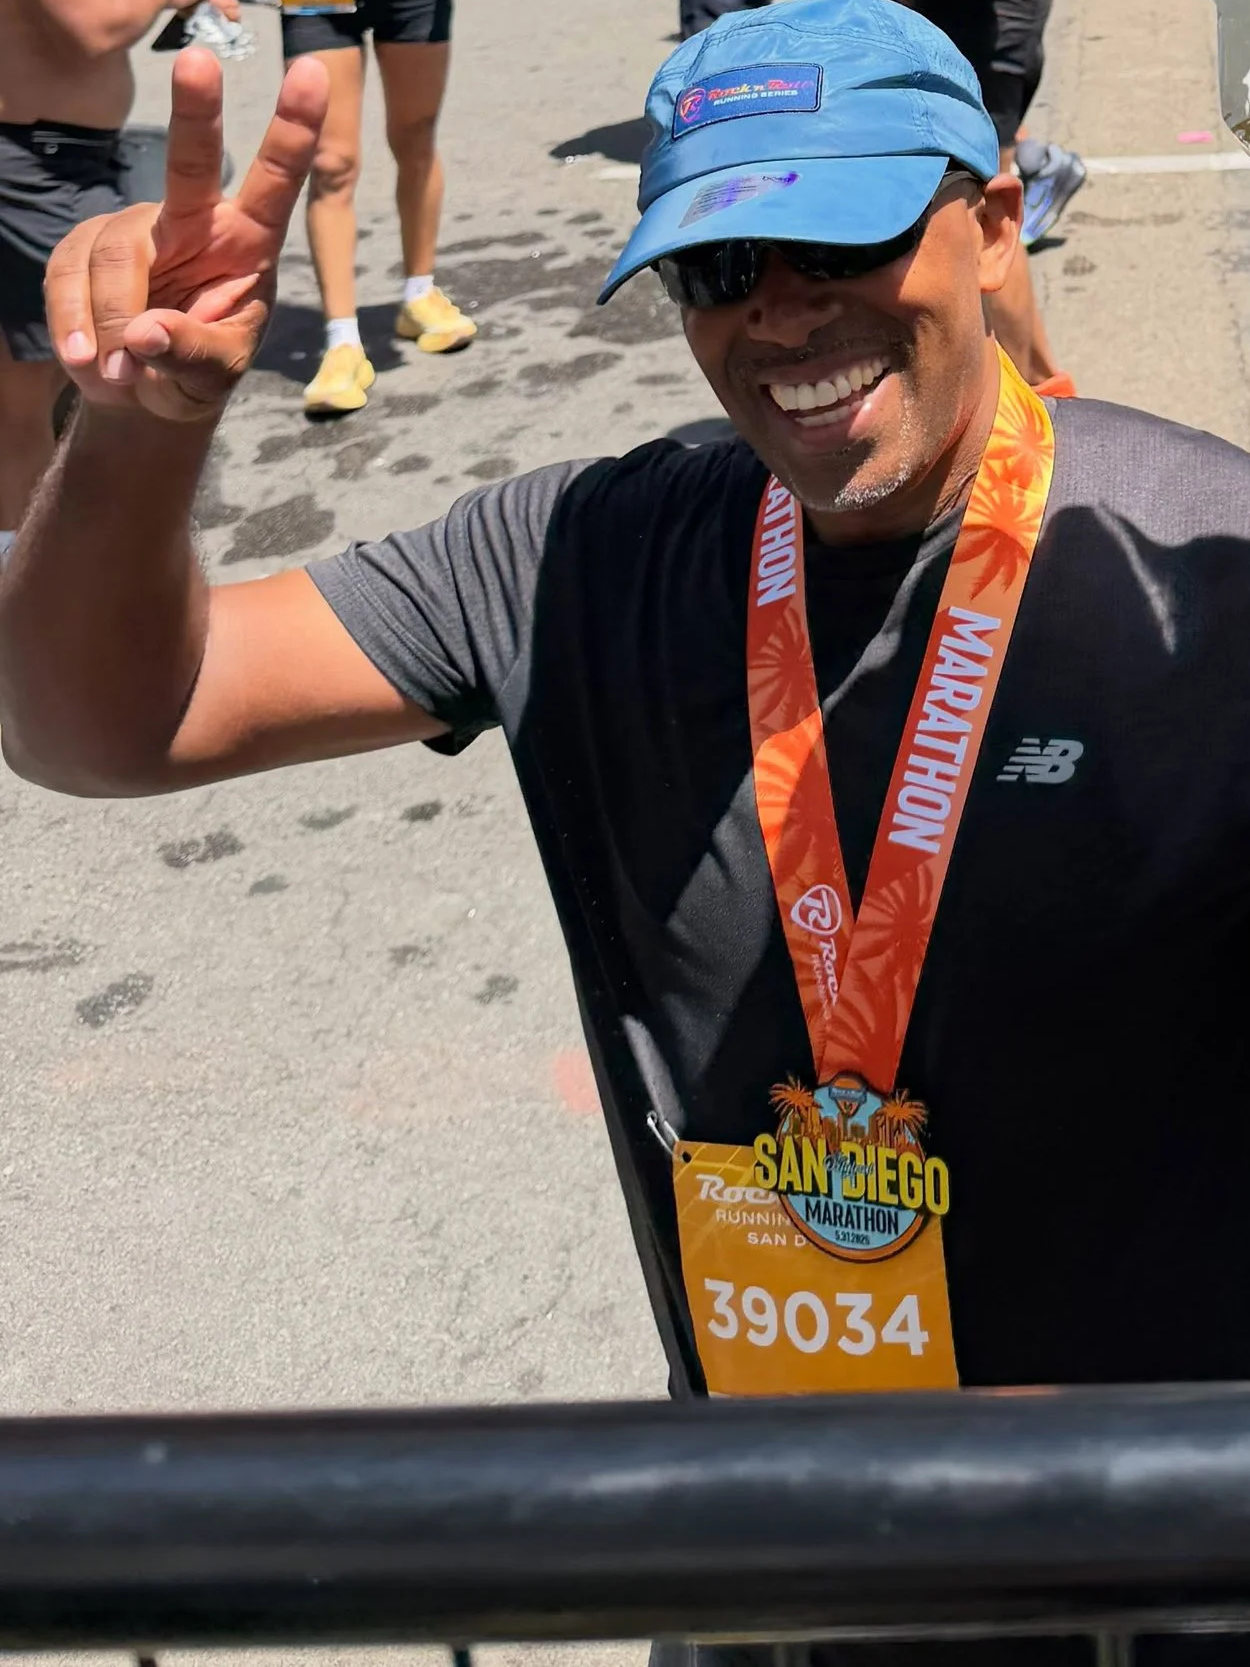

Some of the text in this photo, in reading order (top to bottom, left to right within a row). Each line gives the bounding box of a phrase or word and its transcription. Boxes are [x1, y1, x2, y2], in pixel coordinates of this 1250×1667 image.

[888, 606, 1002, 855] MARATHON
[753, 1134, 949, 1215] SAN DIEGO
[715, 1208, 791, 1227] RUNNIN
[747, 1231, 787, 1247] SAN
[804, 1197, 899, 1236] MARATHON
[704, 1277, 930, 1356] 39034
